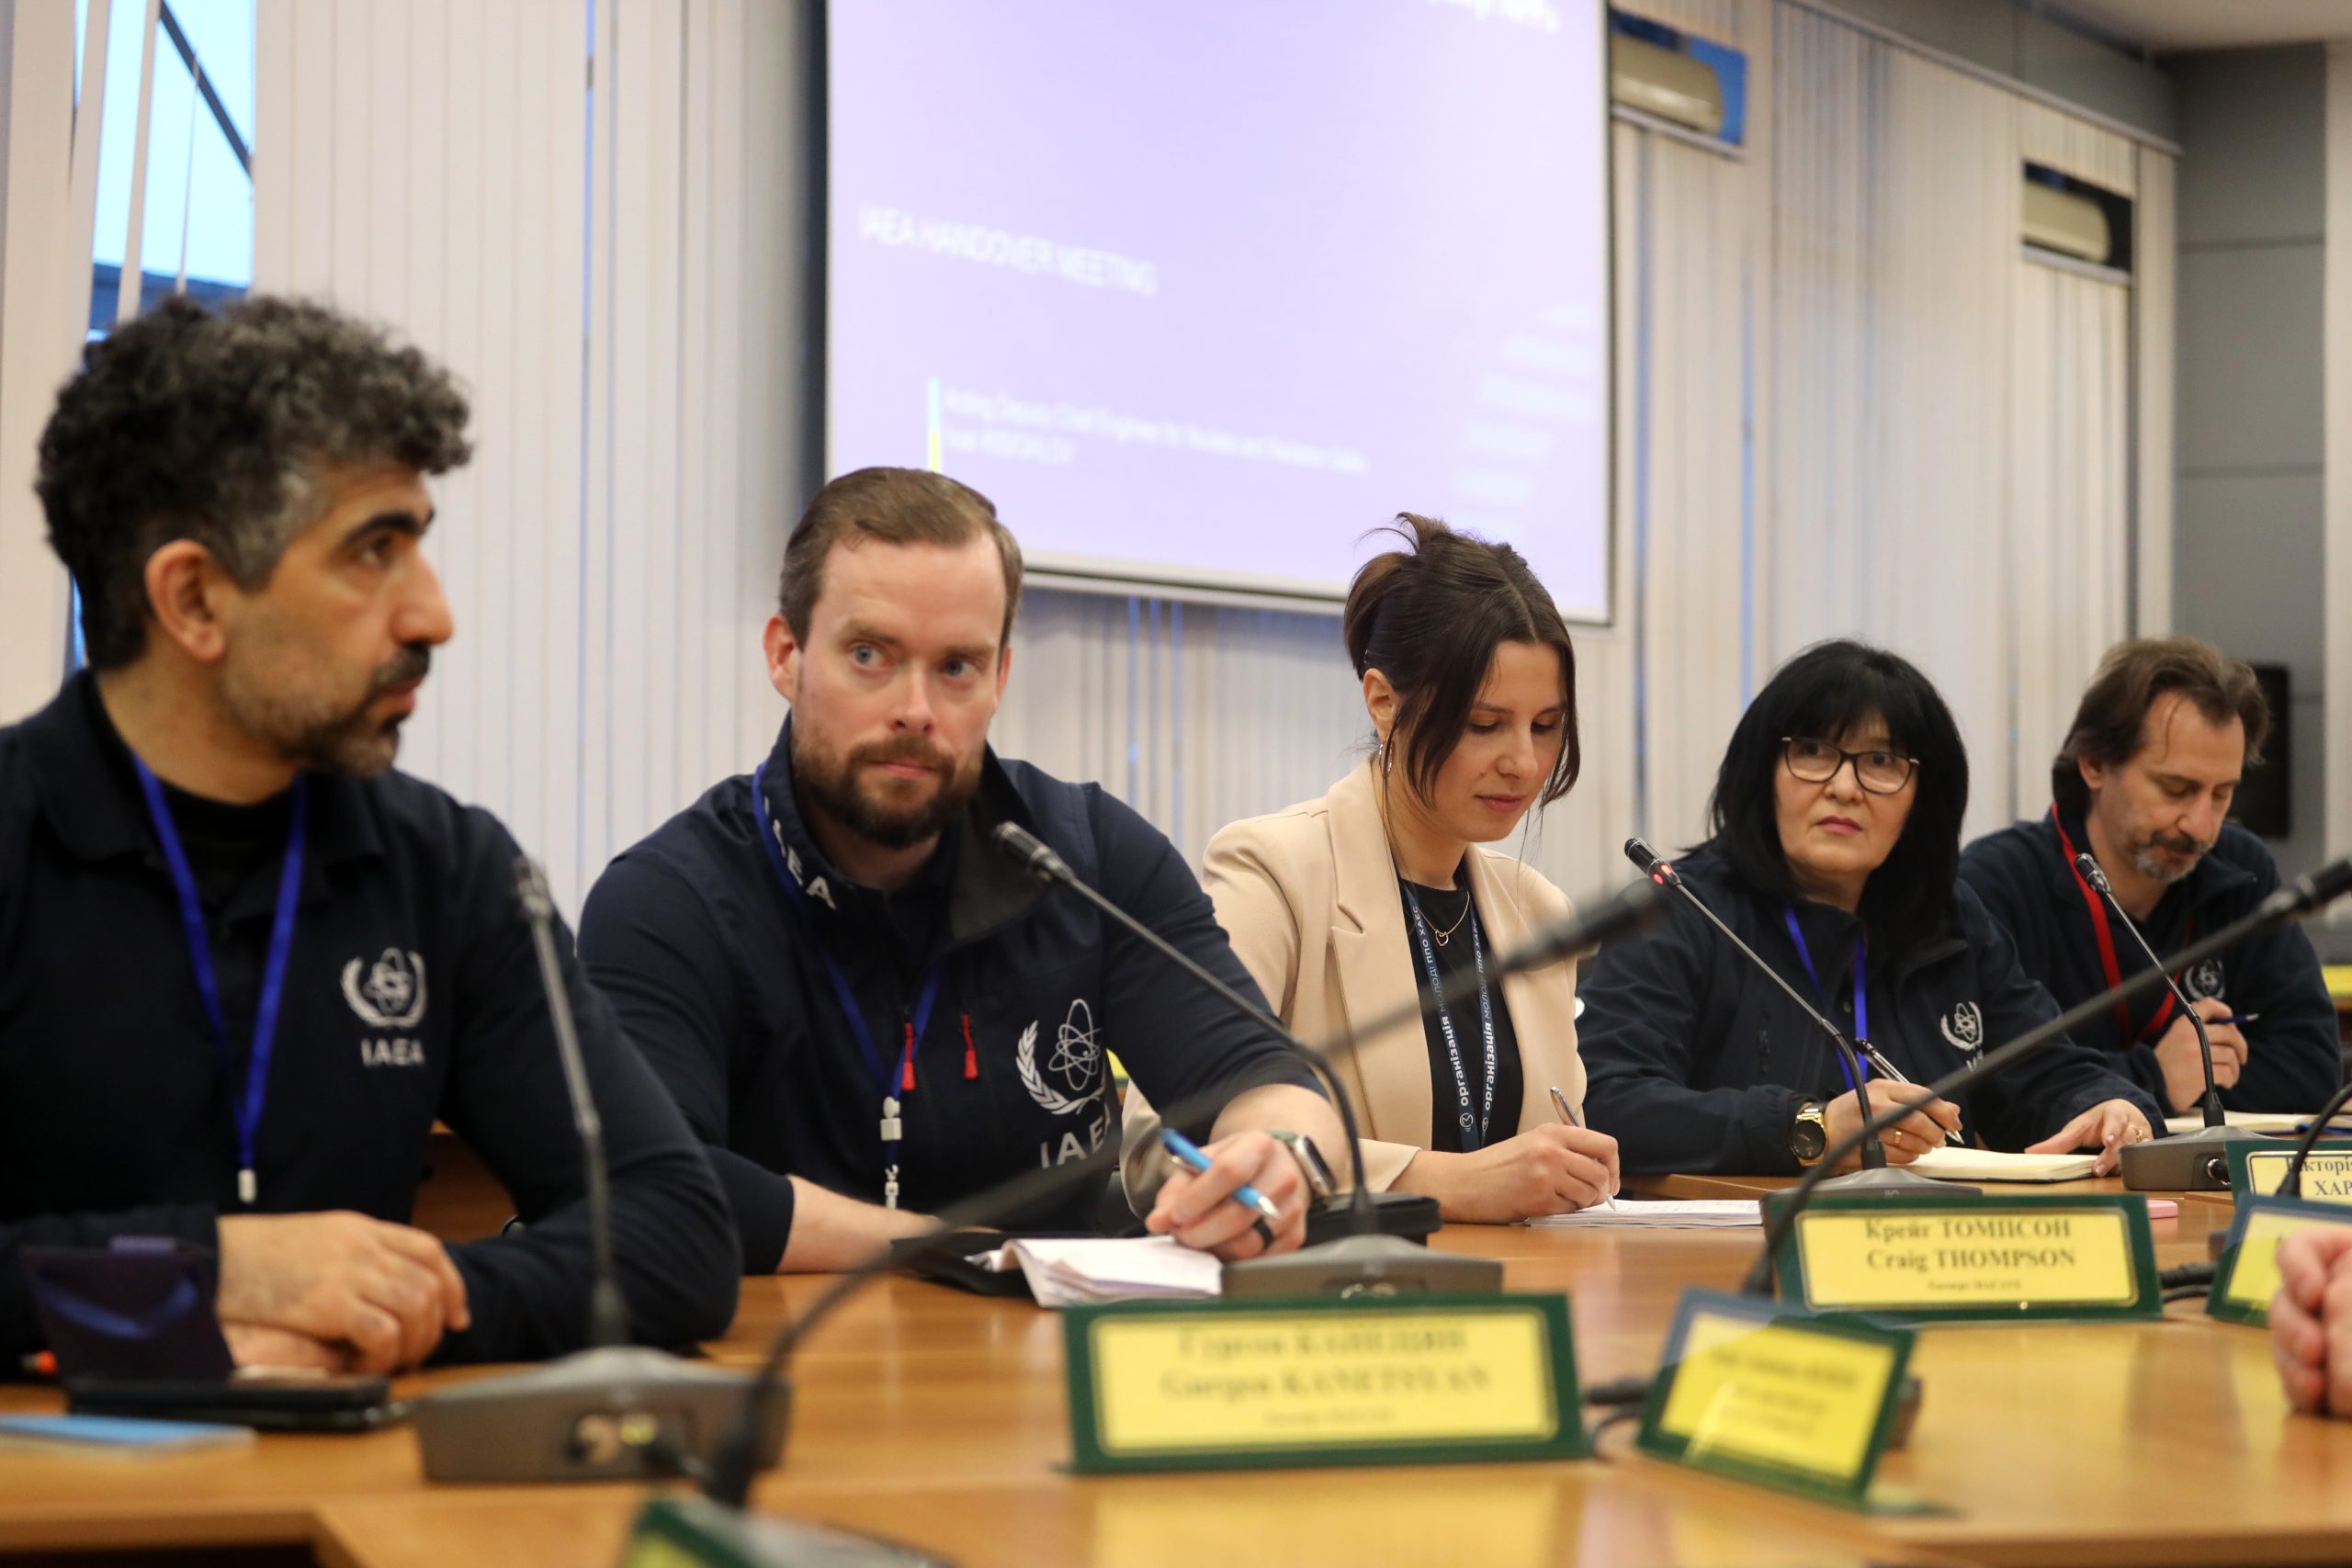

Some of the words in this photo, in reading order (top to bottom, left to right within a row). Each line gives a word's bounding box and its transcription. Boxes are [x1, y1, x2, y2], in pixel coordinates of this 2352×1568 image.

[1412, 906, 1426, 936] ХАЕС
[1422, 939, 1433, 964] ППО
[360, 1038, 425, 1066] IAEA
[1442, 1016, 1470, 1107] організація
[1484, 1022, 1495, 1111] організація
[1040, 1115, 1110, 1169] IAE
[1939, 1218, 2071, 1239] ТОМПСОН
[1867, 1249, 1928, 1271] Craig
[1932, 1247, 2075, 1270] THOMPSON
